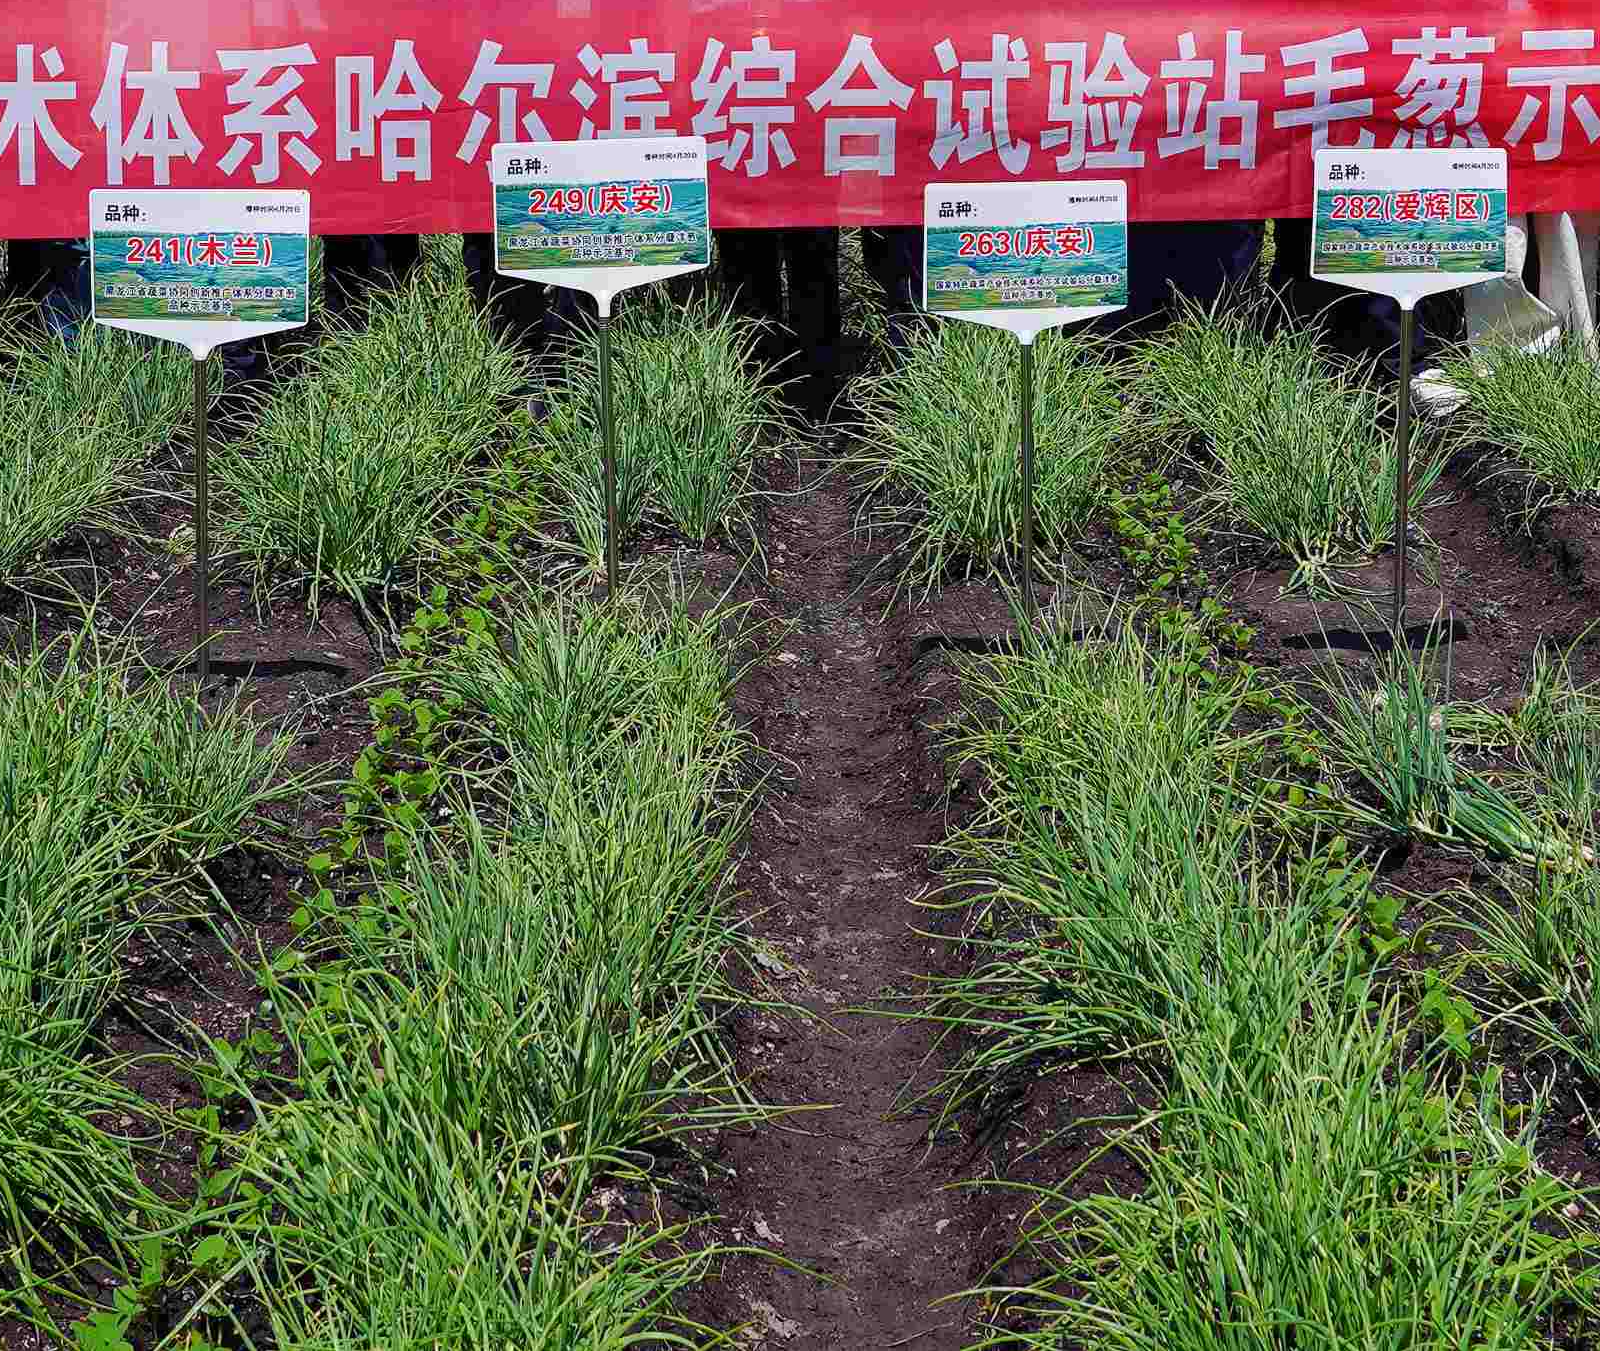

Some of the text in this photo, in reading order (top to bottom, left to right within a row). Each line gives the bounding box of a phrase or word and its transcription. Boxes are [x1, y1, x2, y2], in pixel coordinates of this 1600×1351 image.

[528, 183, 673, 216] 249(庆安)
[1331, 192, 1490, 222] 282(爱辉区)
[126, 234, 273, 267] 241(木兰)
[959, 226, 1096, 258] 263(庆安)
